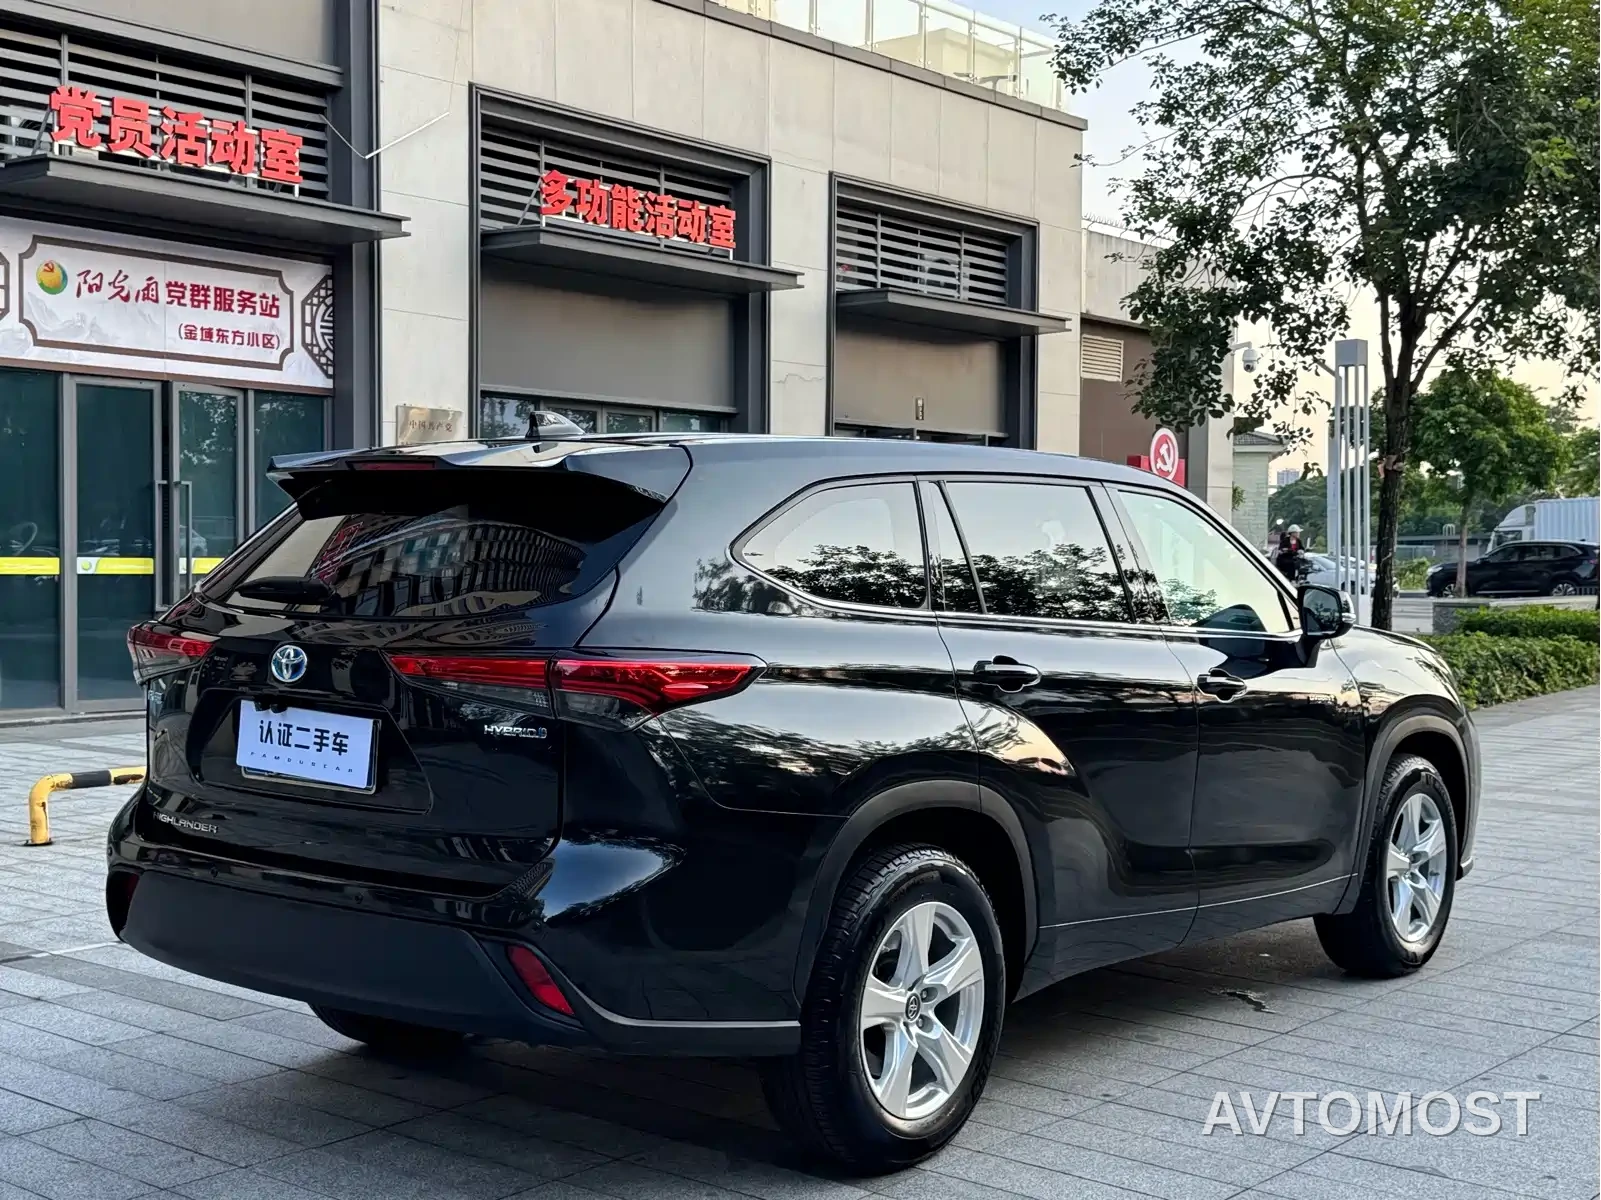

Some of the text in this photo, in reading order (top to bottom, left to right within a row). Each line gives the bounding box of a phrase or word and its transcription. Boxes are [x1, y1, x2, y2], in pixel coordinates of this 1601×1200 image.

[51, 86, 303, 184] 党员活动室
[540, 169, 737, 249] 多功能活动室
[259, 719, 349, 756] 认证二手车
[484, 725, 537, 738] HYBRID
[153, 811, 218, 834] HIGHLANDER
